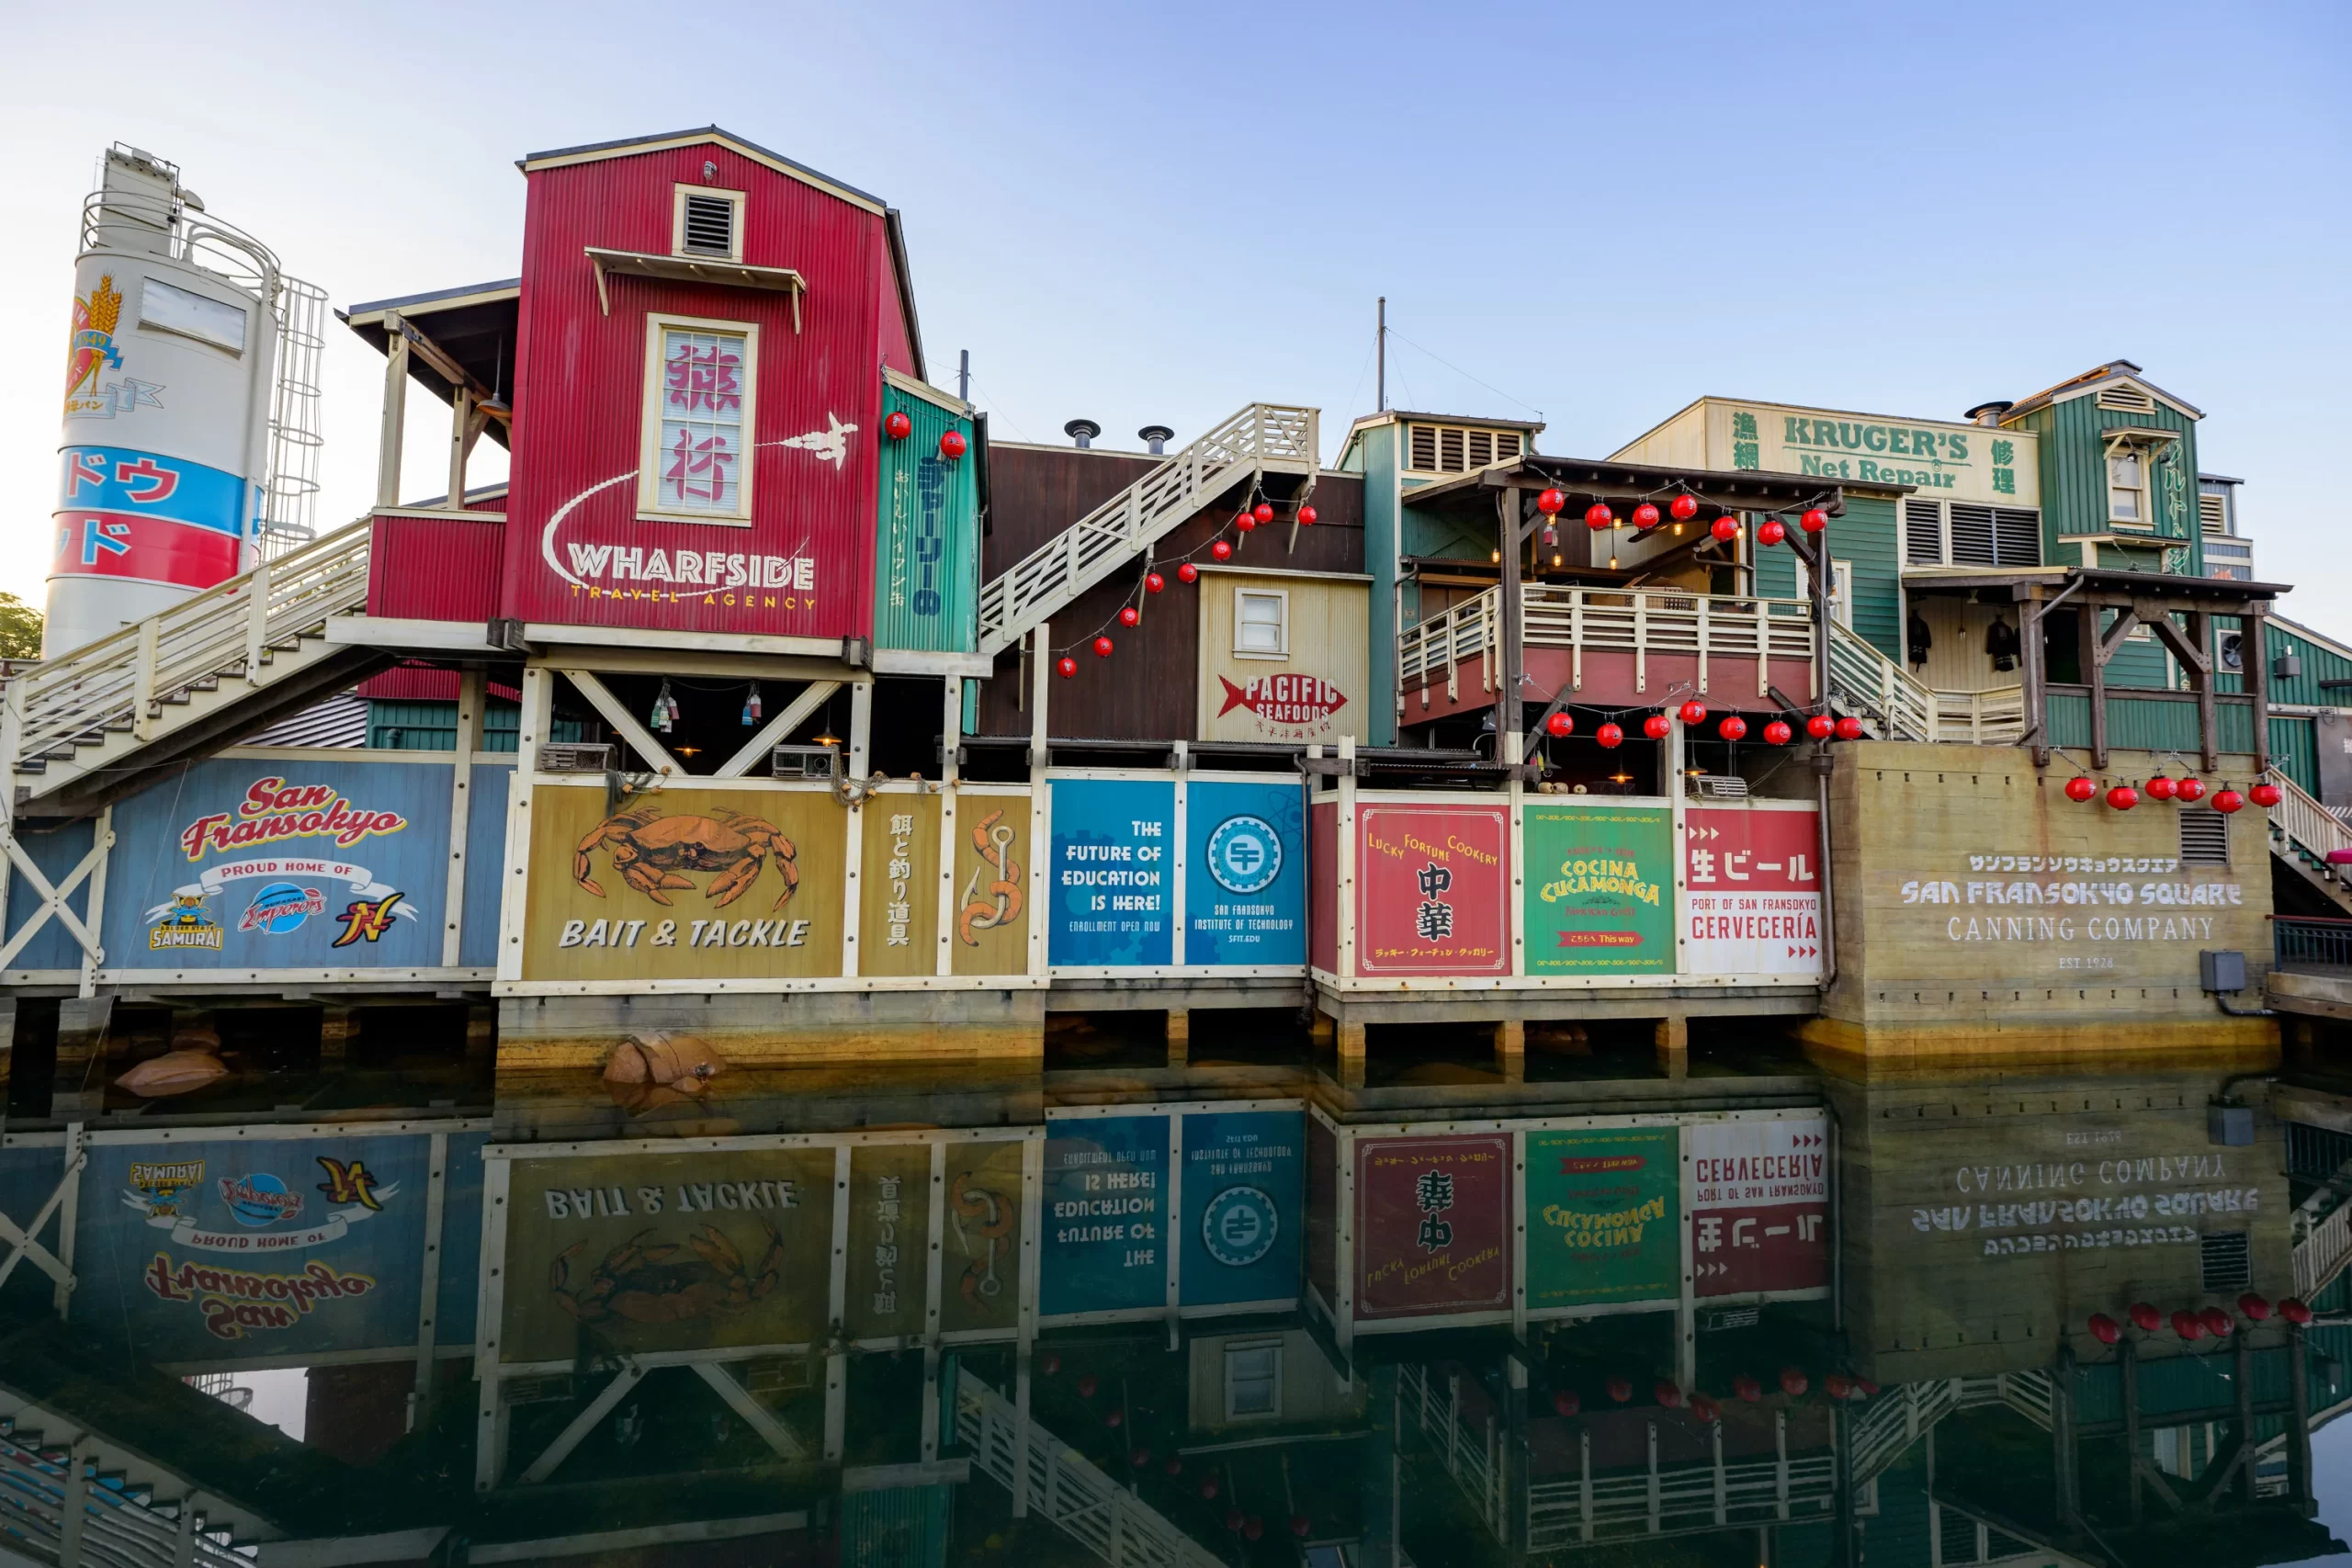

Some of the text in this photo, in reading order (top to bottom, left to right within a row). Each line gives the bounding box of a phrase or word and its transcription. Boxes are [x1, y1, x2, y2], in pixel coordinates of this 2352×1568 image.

[1784, 416, 1969, 459] KRUGER'S
[1801, 455, 1956, 489] Net Repair
[1991, 439, 2016, 495] 修理
[568, 543, 814, 590] WHARFSIDE
[571, 585, 815, 609] TRAVEL AGENCY
[1246, 675, 1338, 705] PACIFIC
[1257, 703, 1329, 722] SEAFOODS
[239, 776, 337, 818] San
[181, 798, 407, 862] Fransokyo
[1132, 820, 1161, 837] THE
[1066, 846, 1161, 861] FUTURE OF
[1368, 833, 1498, 866] LUCKY FORTUNE COOKERY
[221, 862, 353, 878] PROUD HOME OF
[1062, 871, 1160, 886] EDUCATION
[1561, 859, 1639, 881] COCINA
[1690, 849, 1815, 883] 生ビール
[887, 814, 913, 946] 餌と釣り道具
[1540, 876, 1660, 906] CUCAMONGA
[1091, 895, 1160, 910] IS HERE!
[1416, 862, 1453, 942] 中華
[1692, 898, 1816, 910] PORT OF SAN FRANSOKYO
[1901, 881, 2244, 906] SAN FRANSOKYO SQUARE
[238, 897, 327, 934] Emperors
[1215, 905, 1274, 916] SAN FRANSOKYO
[1565, 906, 1608, 917] Mexican
[559, 919, 810, 948] BAIT & TACKLE
[1069, 921, 1160, 931] ENROLLMENT OPEN NOW
[1194, 919, 1294, 930] INSTITUTE OF TECHNOLOGY
[1691, 912, 1817, 940] CERVECERÍA
[1948, 916, 2213, 942] CANNING COMPANY
[153, 930, 220, 947] SAMURAI
[1599, 934, 1617, 943] This
[2059, 957, 2113, 969] EST 1928
